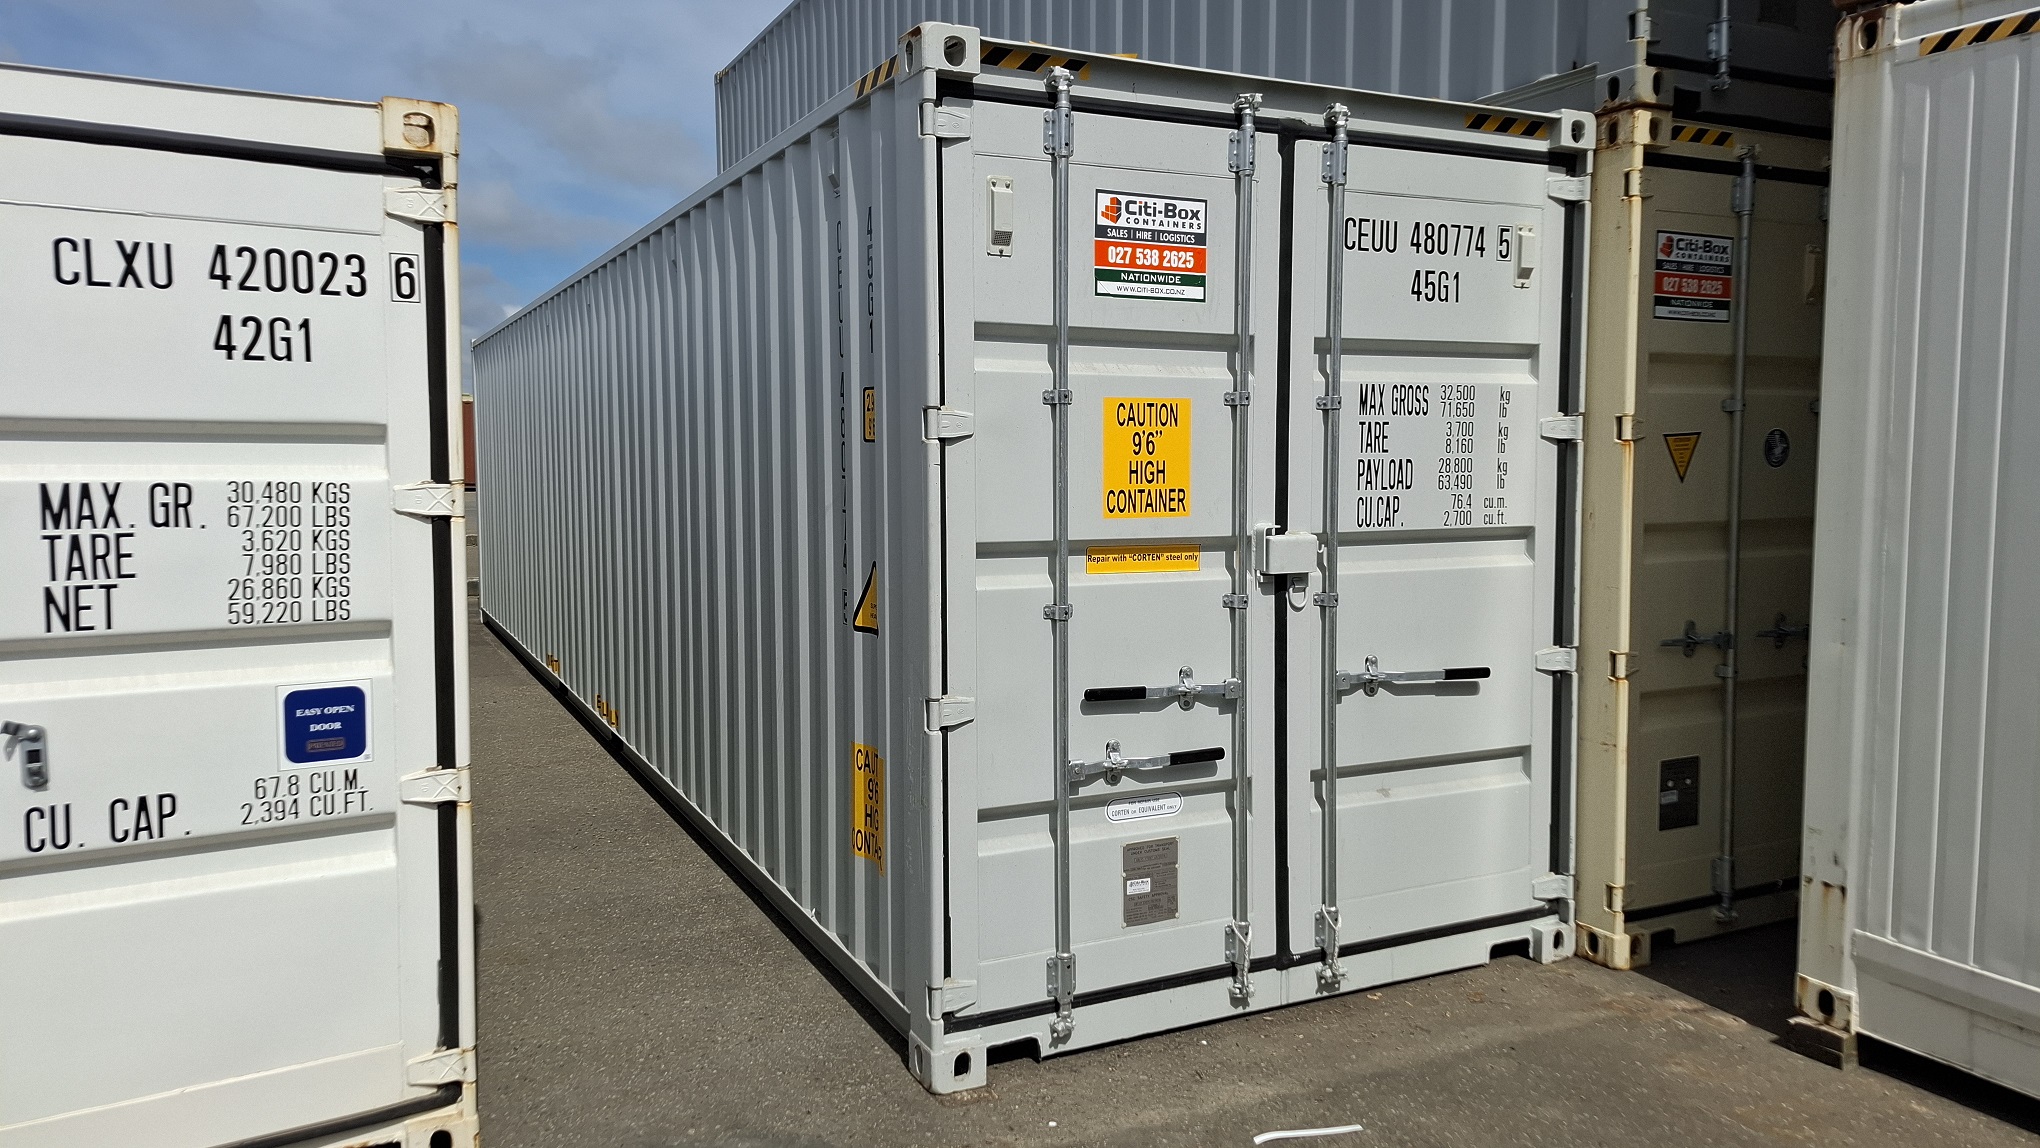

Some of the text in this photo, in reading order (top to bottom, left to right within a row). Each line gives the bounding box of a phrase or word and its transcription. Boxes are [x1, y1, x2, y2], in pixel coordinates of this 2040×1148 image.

[1125, 200, 1201, 221] Citi-Box
[1107, 228, 1195, 244] SALES HIRE LOGISTICS
[1126, 217, 1202, 230] CONTAINERS
[1344, 217, 1511, 259] CEUU 480774 5
[1676, 238, 1729, 255] Citi-Box
[53, 237, 417, 300] CLXU 420023 6
[1108, 246, 1194, 269] 027 538 2625
[1121, 272, 1182, 284] NATIONWIDE
[1410, 269, 1460, 303] 45G1
[213, 314, 313, 363] 42G1
[1358, 383, 1386, 416] MAX
[1391, 384, 1430, 416] GROSS
[1500, 386, 1511, 404] kg
[1499, 403, 1508, 418] lb
[1116, 402, 1179, 428] CAUTION
[1358, 421, 1390, 453] TARE
[1498, 422, 1509, 440] kg
[1497, 438, 1506, 453] lb
[1129, 460, 1166, 485] HIGH
[1357, 458, 1413, 491] PAYLOAD
[1497, 458, 1508, 475] kg
[1496, 474, 1505, 489] lb
[39, 480, 350, 531] MAX. GR. 30,480 KGS
[1106, 488, 1187, 514] CONTAINER
[1450, 493, 1472, 509] 76.4
[1483, 497, 1508, 509] cu.m.
[227, 505, 350, 528] 67,200 LBS
[1483, 510, 1508, 525] cu.ft.
[40, 529, 350, 582] TARE 3,620 KGS
[242, 552, 350, 577] 7,980 LBS
[1087, 555, 1110, 564] Repair
[1112, 553, 1127, 562] with
[1165, 553, 1183, 561] steel
[1184, 552, 1199, 562] only
[43, 576, 350, 634] NET 26,860 KGS
[227, 600, 350, 625] 59,220 LBS
[296, 704, 355, 717] EASY OPEN
[310, 721, 342, 732] DOOR
[254, 768, 364, 800] 67.8 CU.M.
[24, 790, 374, 854] CU. CAP. 2,394 CU.FT.
[1111, 808, 1130, 817] CORTEN
[1138, 803, 1167, 813] EQUIVALENT
